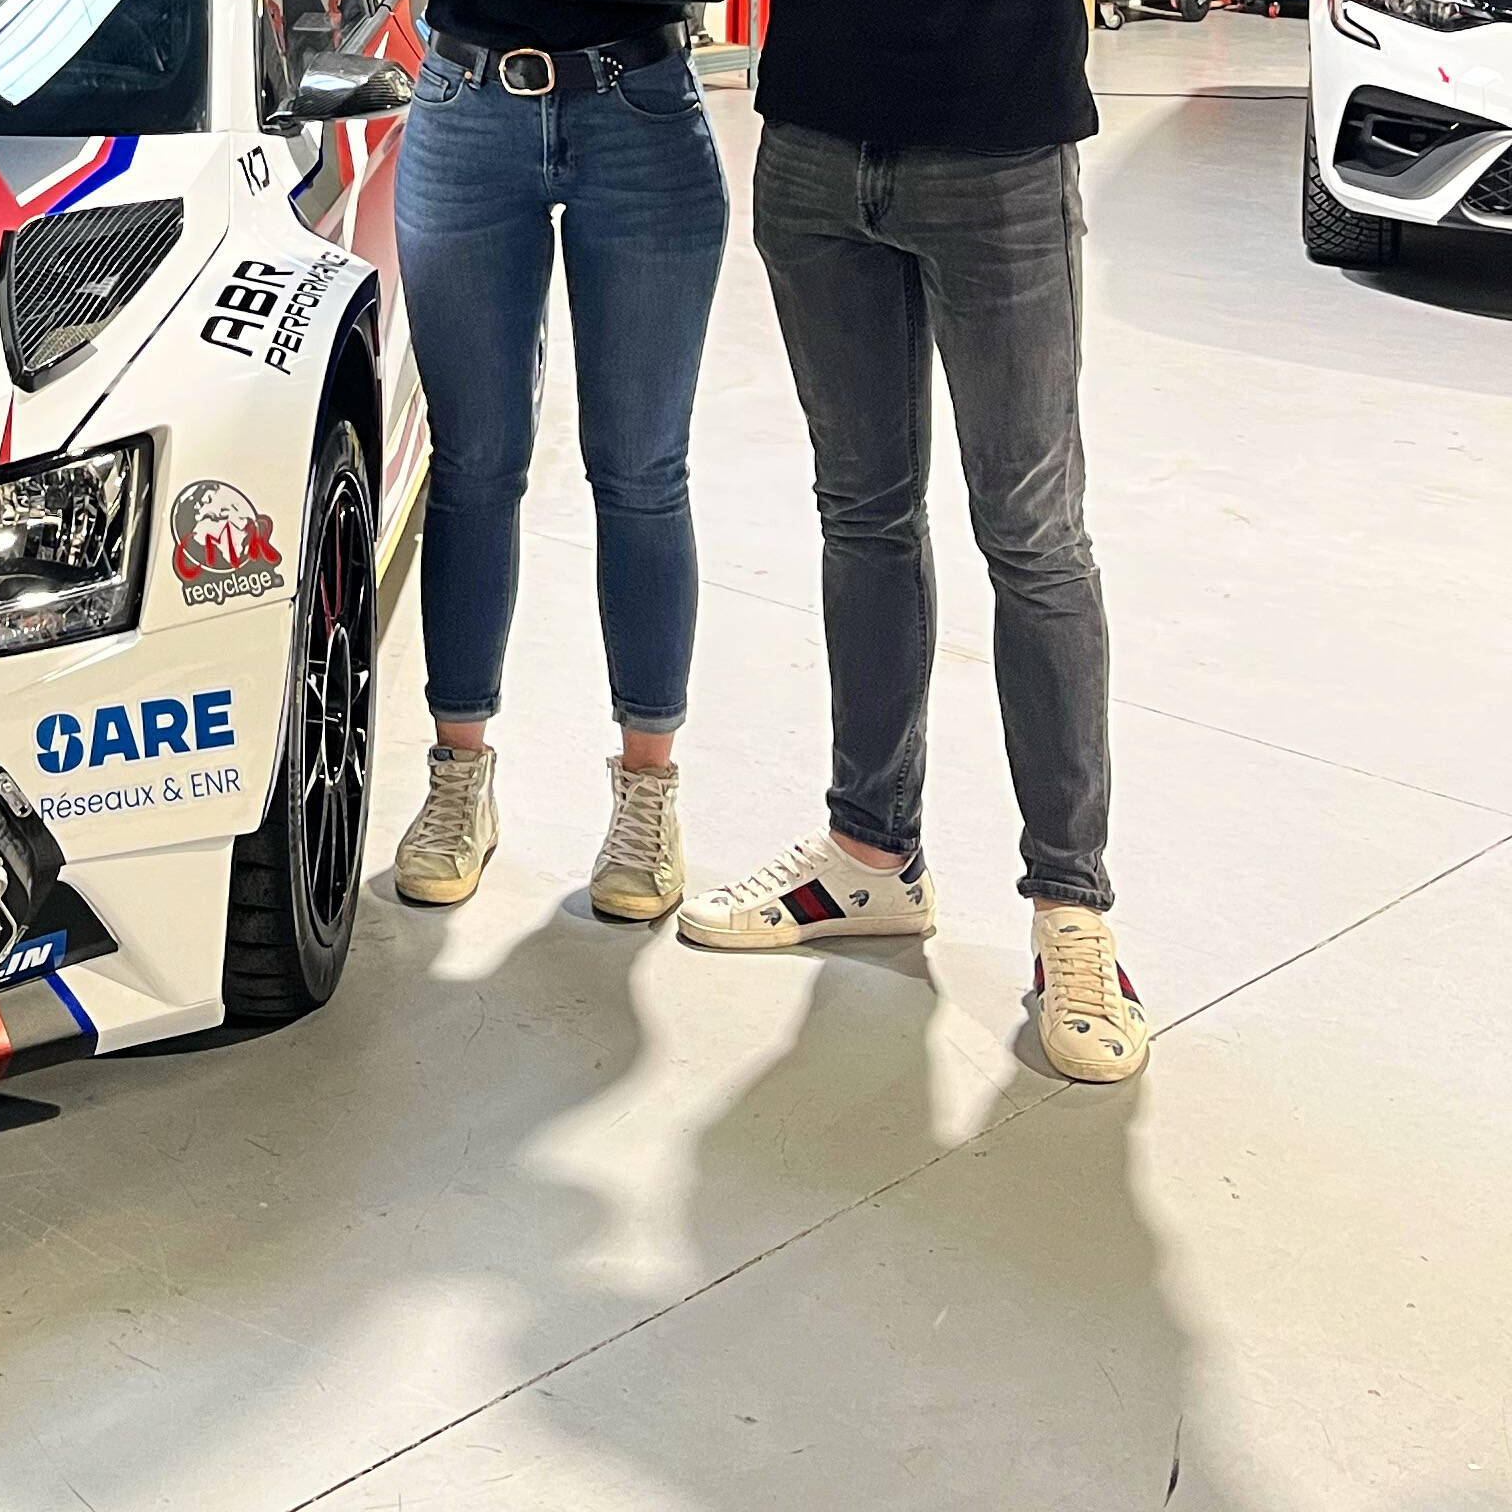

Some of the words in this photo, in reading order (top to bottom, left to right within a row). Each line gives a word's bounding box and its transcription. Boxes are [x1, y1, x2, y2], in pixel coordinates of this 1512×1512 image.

[199, 260, 295, 357] ABR
[184, 570, 272, 603] recyclage
[40, 785, 155, 823] Réseaux
[161, 777, 184, 802] &
[190, 768, 242, 798] ENR
